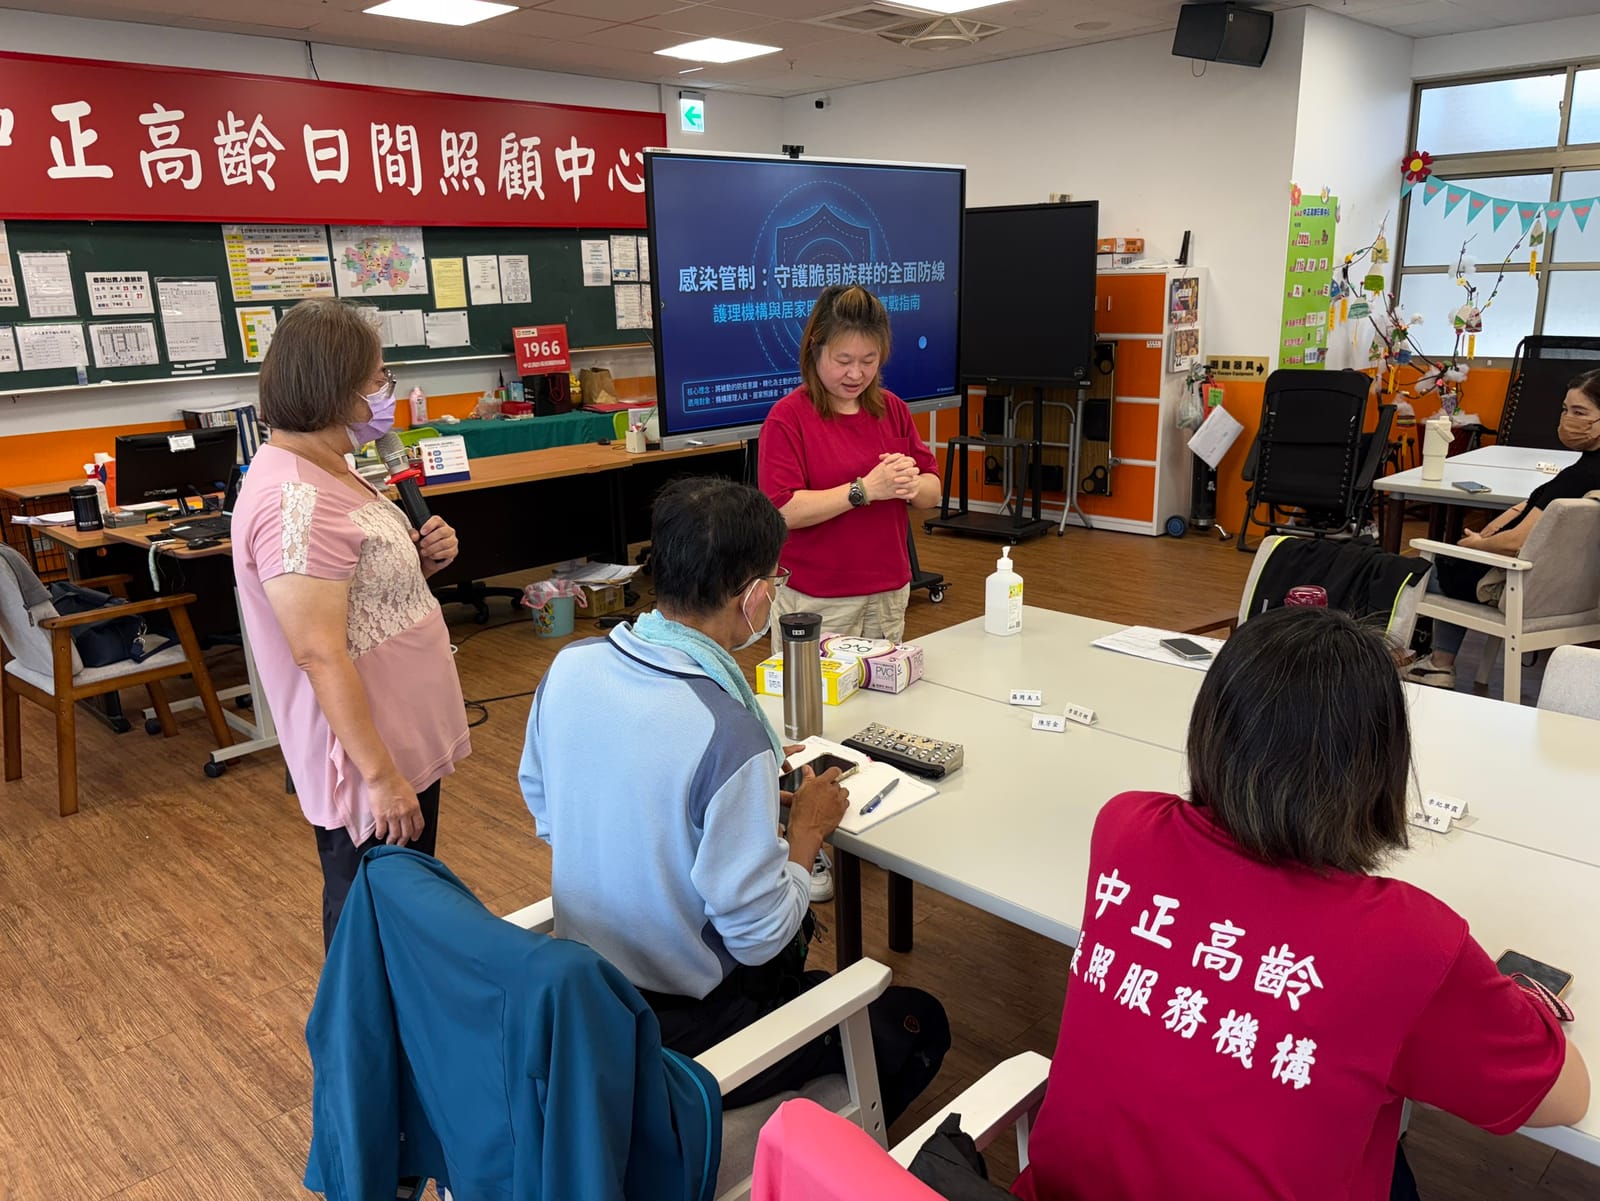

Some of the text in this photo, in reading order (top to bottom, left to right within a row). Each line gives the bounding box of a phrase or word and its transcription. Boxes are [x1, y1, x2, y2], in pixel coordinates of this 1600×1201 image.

[678, 261, 946, 293] 感染管制：守護脆弱族群的全面防線
[523, 340, 562, 358] 1966
[875, 666, 895, 677] PVC
[1095, 868, 1324, 1012] 中正高齡
